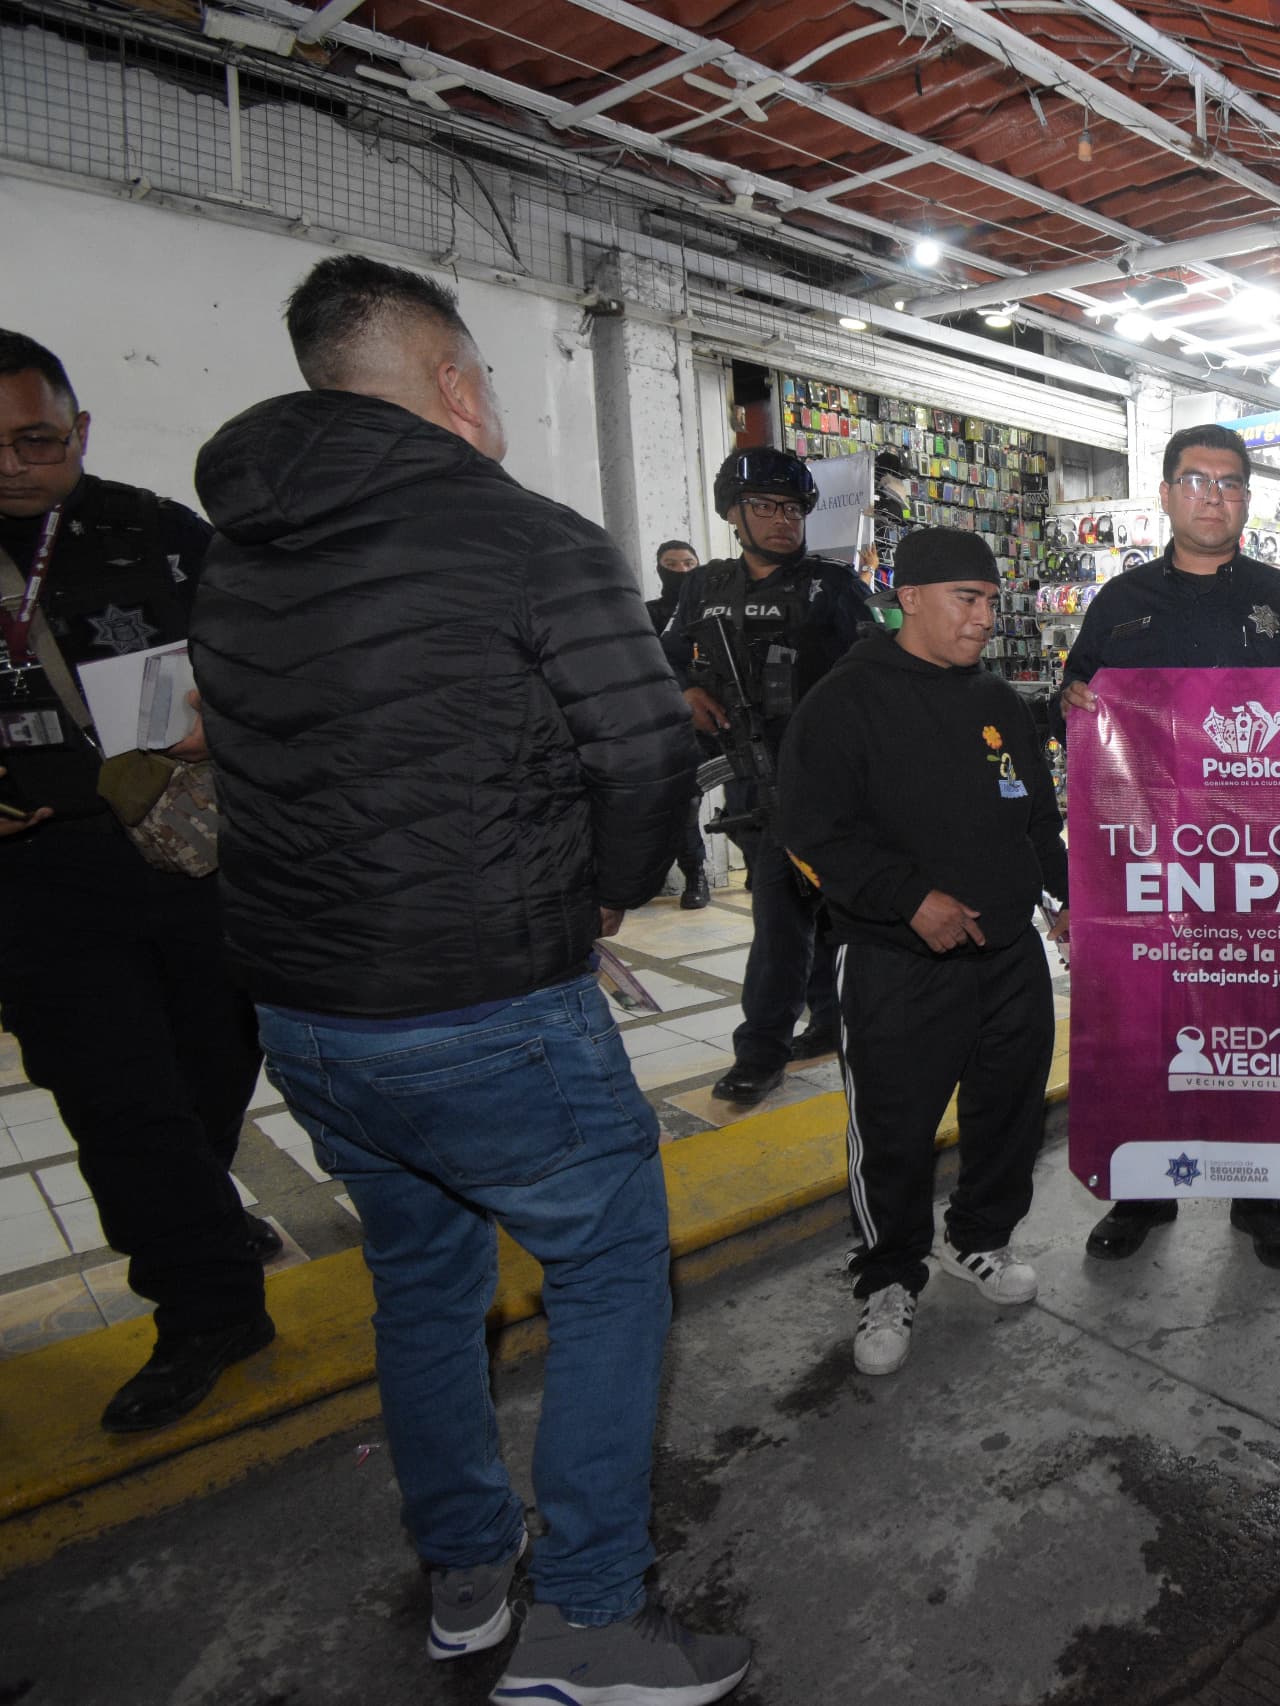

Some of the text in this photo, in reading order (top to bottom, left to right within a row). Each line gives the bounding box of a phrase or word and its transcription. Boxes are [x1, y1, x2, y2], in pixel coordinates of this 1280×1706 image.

[703, 604, 782, 619] POLCIA
[1100, 824, 1157, 856] TU
[1126, 862, 1216, 913] EN
[1172, 924, 1243, 942] Vecinas,
[1132, 942, 1213, 962] Policía
[1219, 943, 1248, 961] de
[1253, 943, 1275, 962] la
[1172, 969, 1270, 987] trabajando
[1211, 1026, 1268, 1050] RED
[1186, 1078, 1235, 1087] VECINO
[1209, 1166, 1269, 1176] SEGURIDAD
[1209, 1174, 1269, 1183] CIUDADANA
